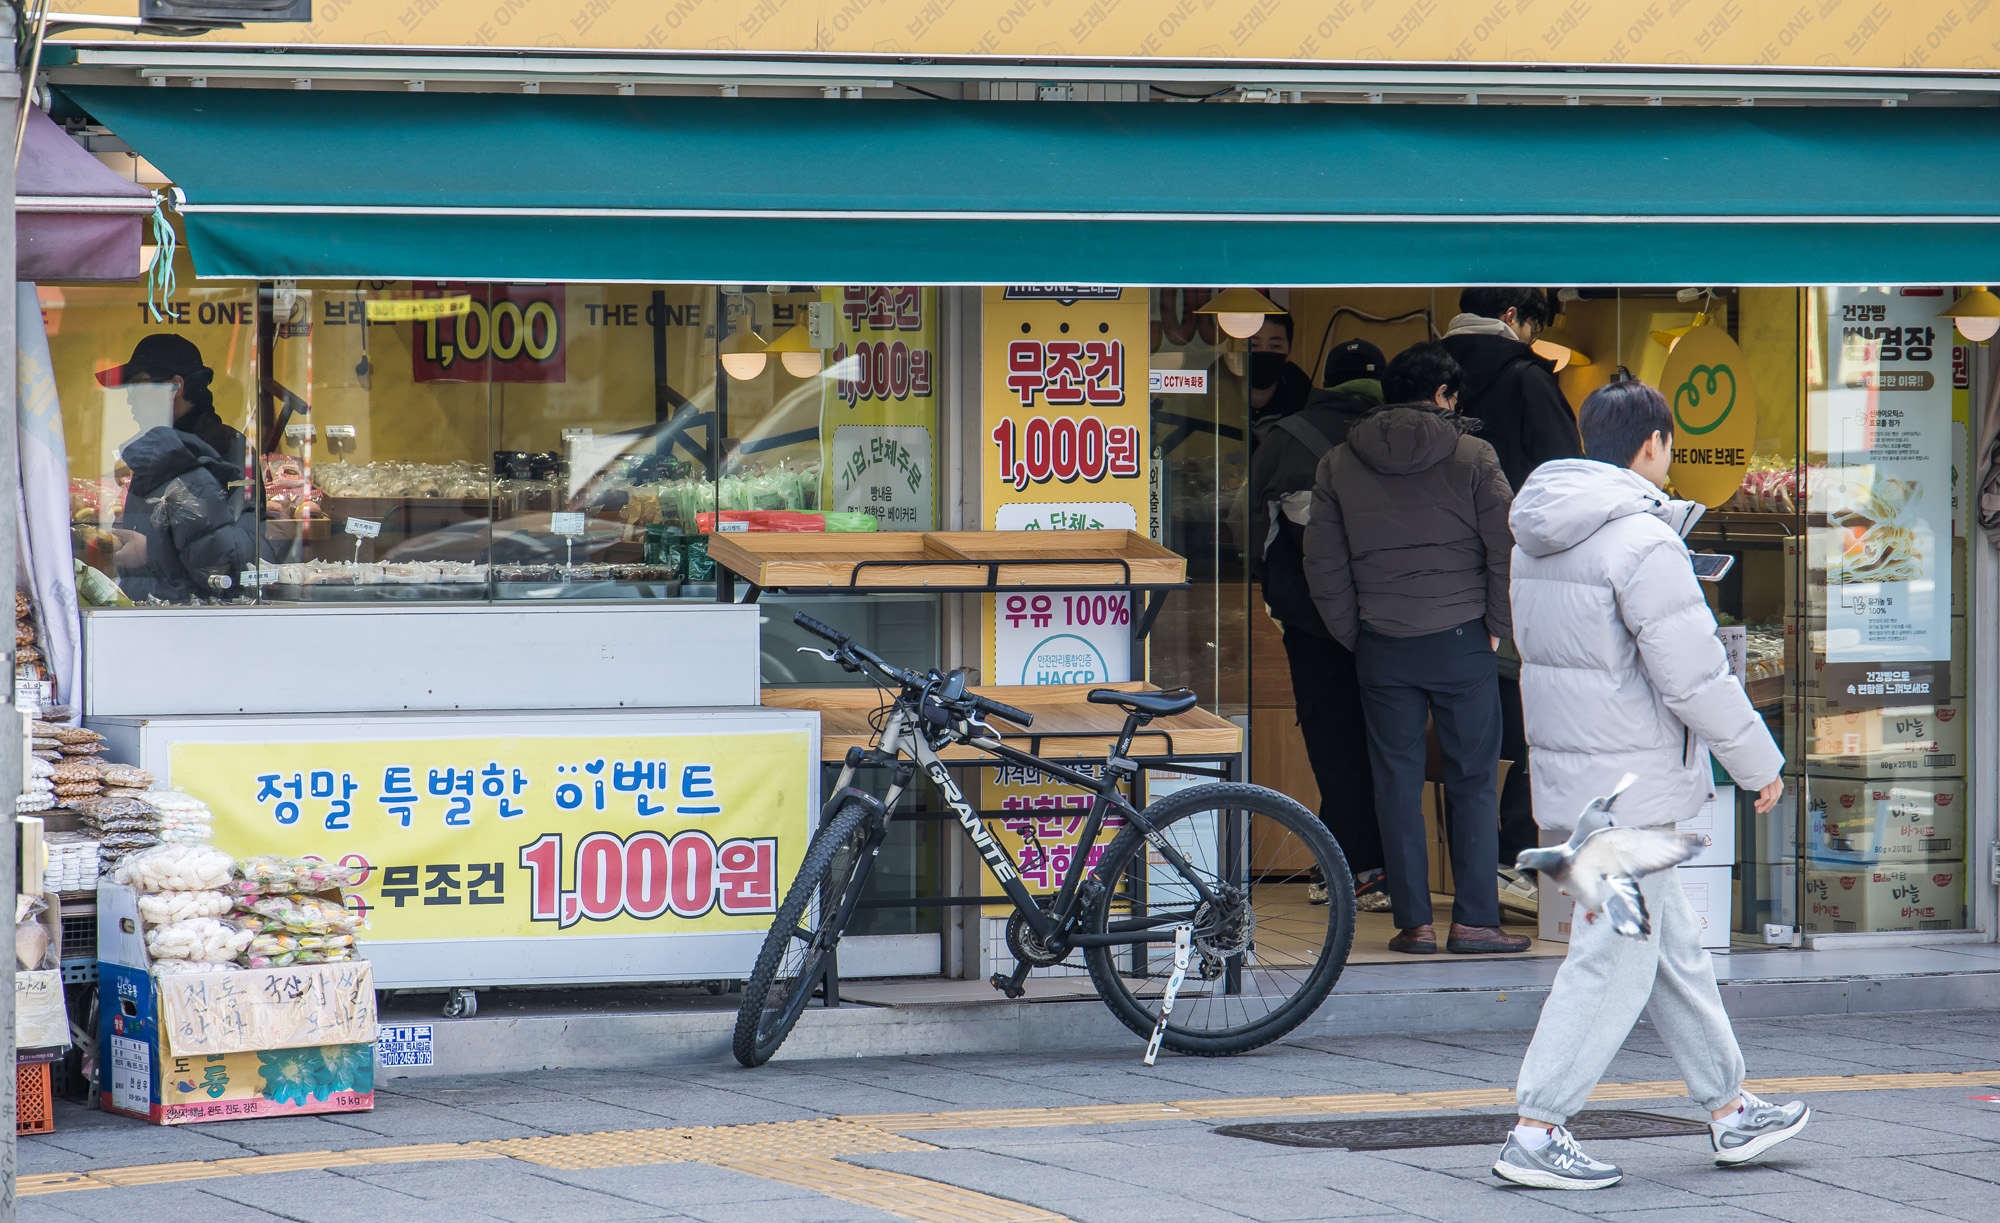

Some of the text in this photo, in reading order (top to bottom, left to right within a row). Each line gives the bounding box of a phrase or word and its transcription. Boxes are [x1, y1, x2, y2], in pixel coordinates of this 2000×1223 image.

[1316, 1, 1357, 39] ONE
[1387, 0, 1438, 49] 브레드
[1473, 1, 1511, 41] ONE
[1542, 0, 1592, 50] 브레드
[1626, 3, 1664, 44] ONE
[1694, 1, 1744, 53] 브레드
[1777, 5, 1814, 47] ONE
[1844, 1, 1893, 56] 브레드
[1925, 8, 1963, 51] ONE
[138, 302, 253, 325] THE ONE
[585, 304, 637, 327] THE
[1843, 304, 1886, 322] 건강빵
[1007, 339, 1125, 406] 무조건
[1879, 375, 1896, 387] 편한
[1898, 375, 1924, 388] 이유!!
[992, 416, 1140, 491] 1,000원
[1689, 449, 1712, 464] ONE
[1715, 448, 1745, 467] 브레드
[870, 486, 893, 502] 빵내음
[887, 506, 917, 523] 베이커리
[1005, 595, 1130, 628] 우유 100%
[1868, 607, 1887, 615] 100%
[1036, 671, 1095, 686] HACCP
[1866, 671, 1910, 683] 건강빵으로
[1847, 683, 1930, 695] 속 편함을 느껴보세요
[1896, 717, 1924, 738] 마늘
[256, 757, 722, 831] 정말 특별한 이벤트
[926, 760, 1017, 884] GRANITE
[1901, 825, 1935, 837] 바게뜨
[381, 862, 505, 908] 무조건
[519, 829, 778, 930] 1,000원
[1807, 879, 1828, 900] 마늘
[1892, 883, 1920, 904] 마늘
[1813, 902, 1840, 918] 바게뜨
[1901, 906, 1936, 918] 바게뜨
[380, 1027, 431, 1042] 휴대폰
[207, 1105, 224, 1117] 완도,
[225, 1104, 241, 1115] 진도,
[243, 1102, 258, 1114] 강진
[336, 1097, 360, 1107] 15 kg
